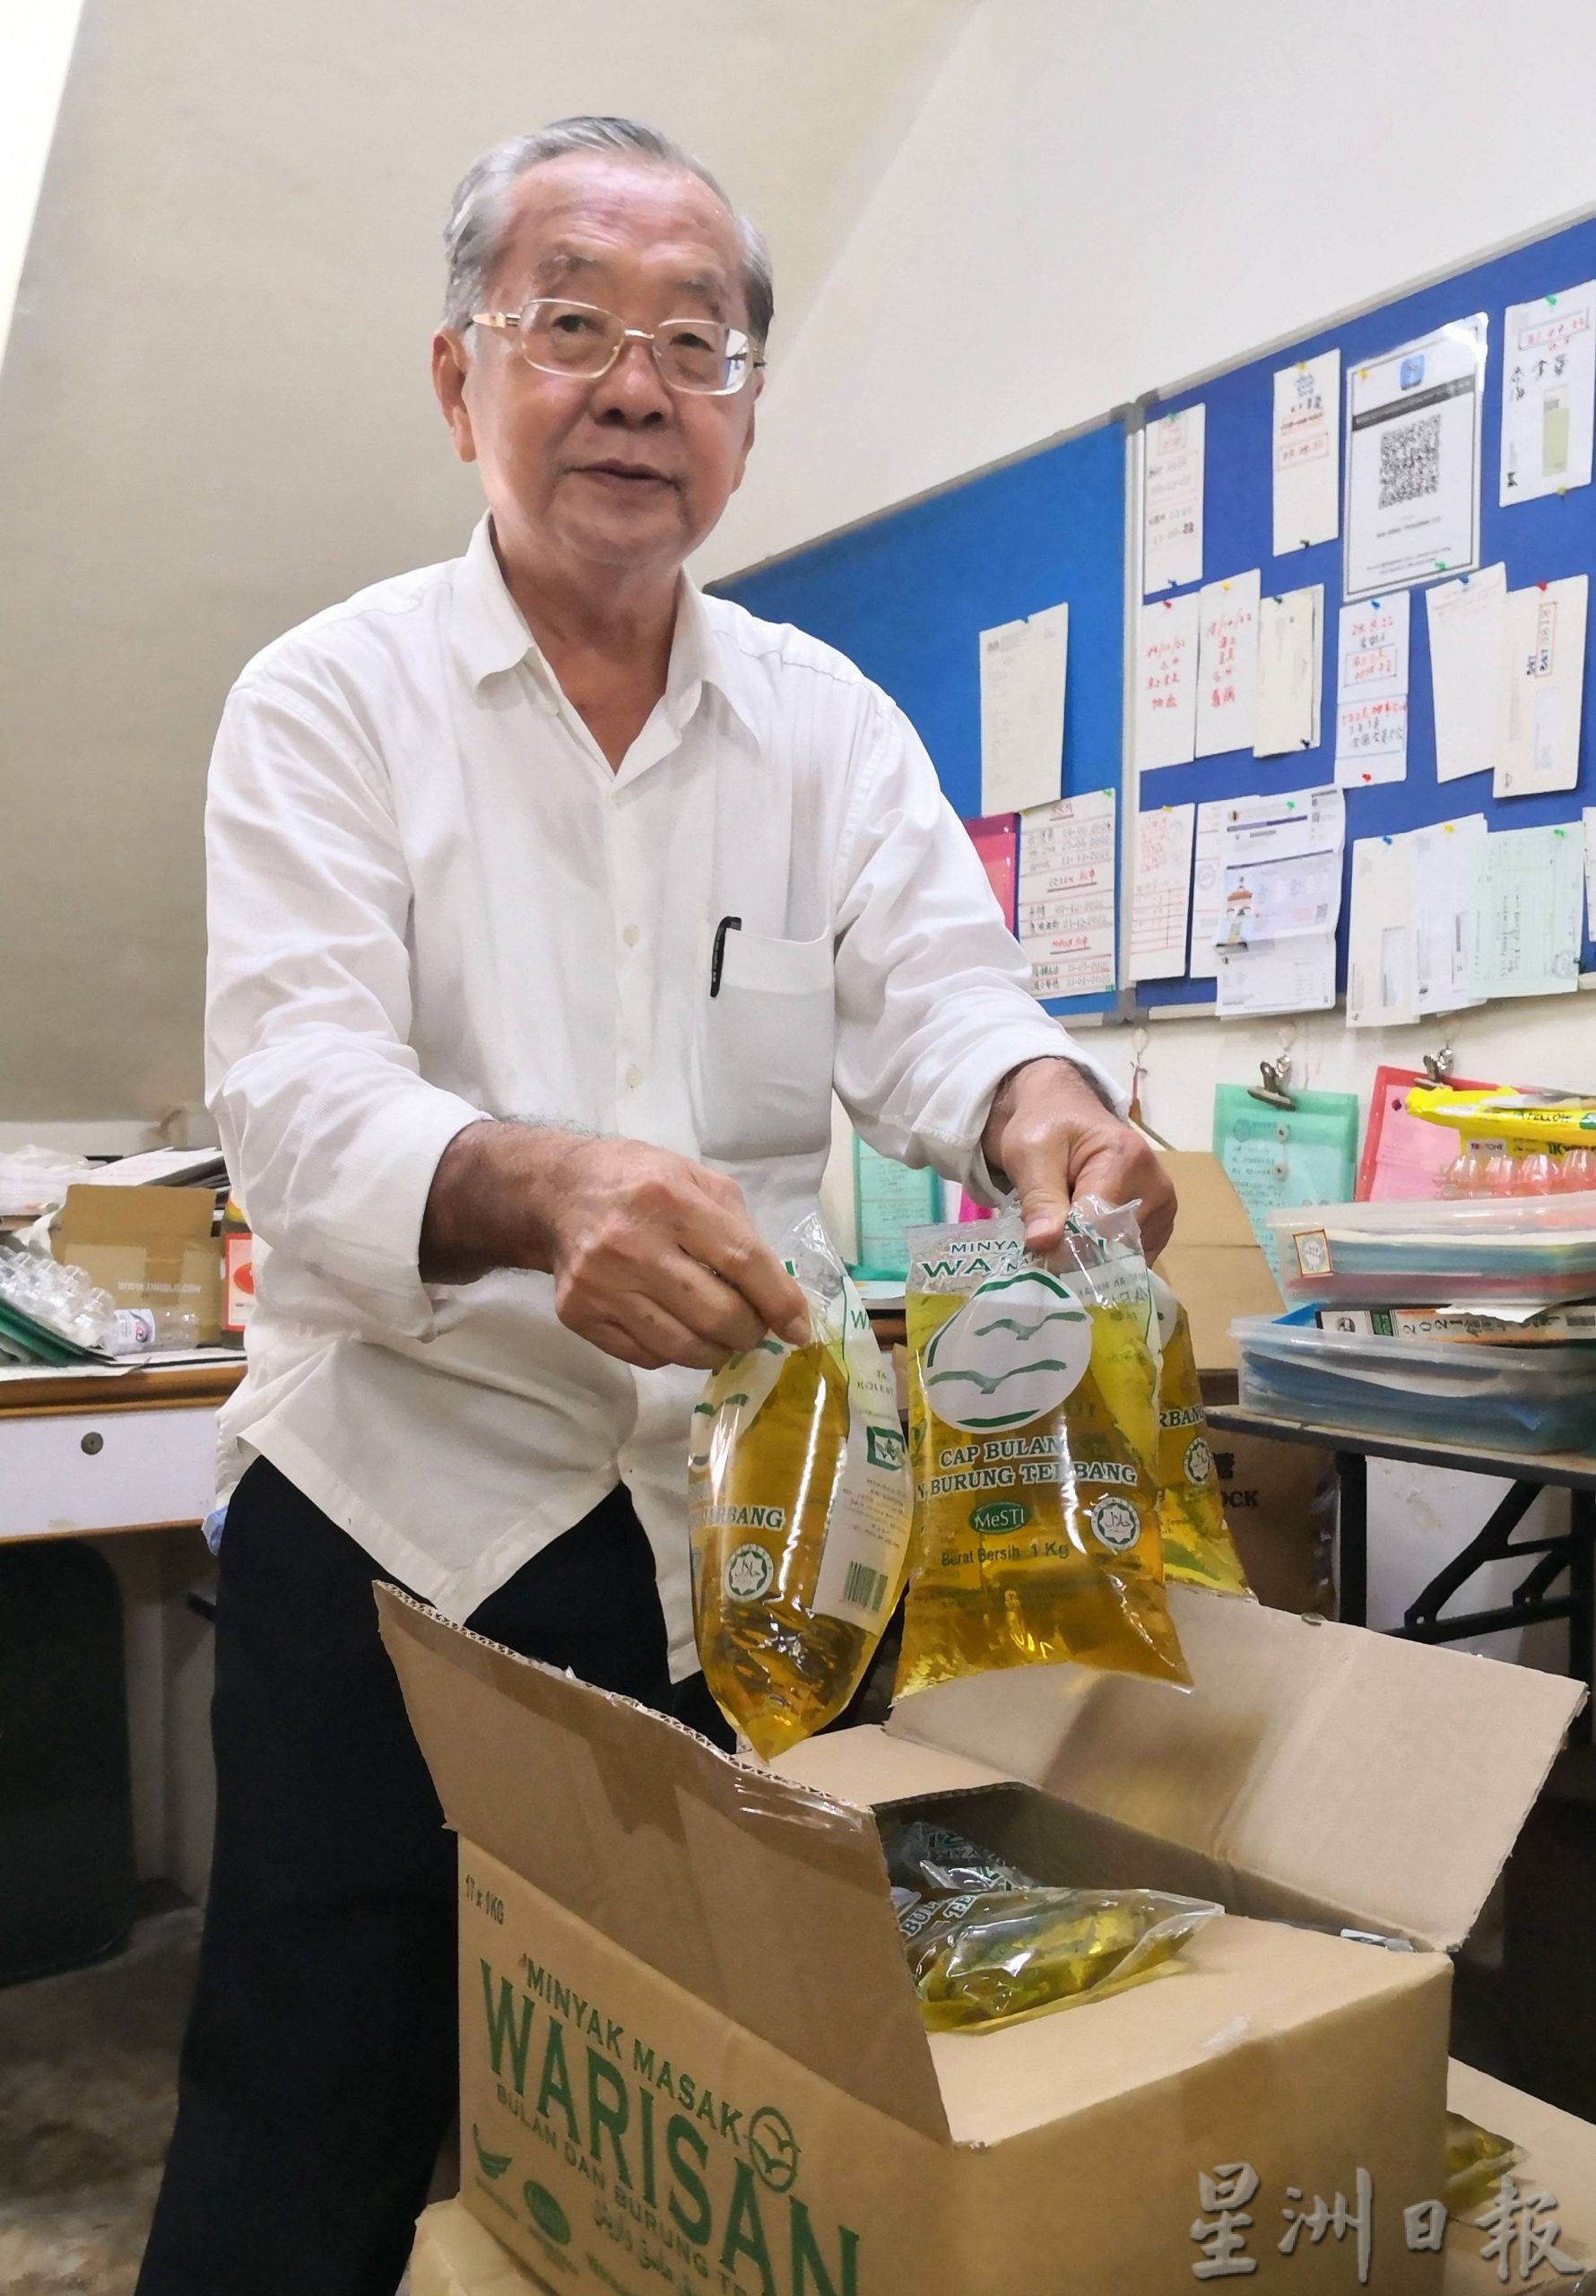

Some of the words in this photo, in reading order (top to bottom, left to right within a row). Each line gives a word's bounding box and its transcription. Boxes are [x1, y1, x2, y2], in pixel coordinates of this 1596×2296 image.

[950, 1240, 1019, 1253] MINYA
[941, 1446, 979, 1467] CAP
[985, 1437, 1061, 1459] BULAN
[931, 1467, 1014, 1494] BURUNG
[975, 1508, 1025, 1529] MeSTI
[941, 1550, 975, 1567] Berat
[978, 1544, 1020, 1562] Bersih
[1029, 1544, 1038, 1557] 1
[1045, 1541, 1070, 1559] Kg
[525, 1957, 624, 2058] MINYAK
[632, 2038, 743, 2146] MASAK
[480, 1958, 861, 2296] WARISAN
[564, 2141, 605, 2190] DAN
[614, 2183, 709, 2279] BURUNG
